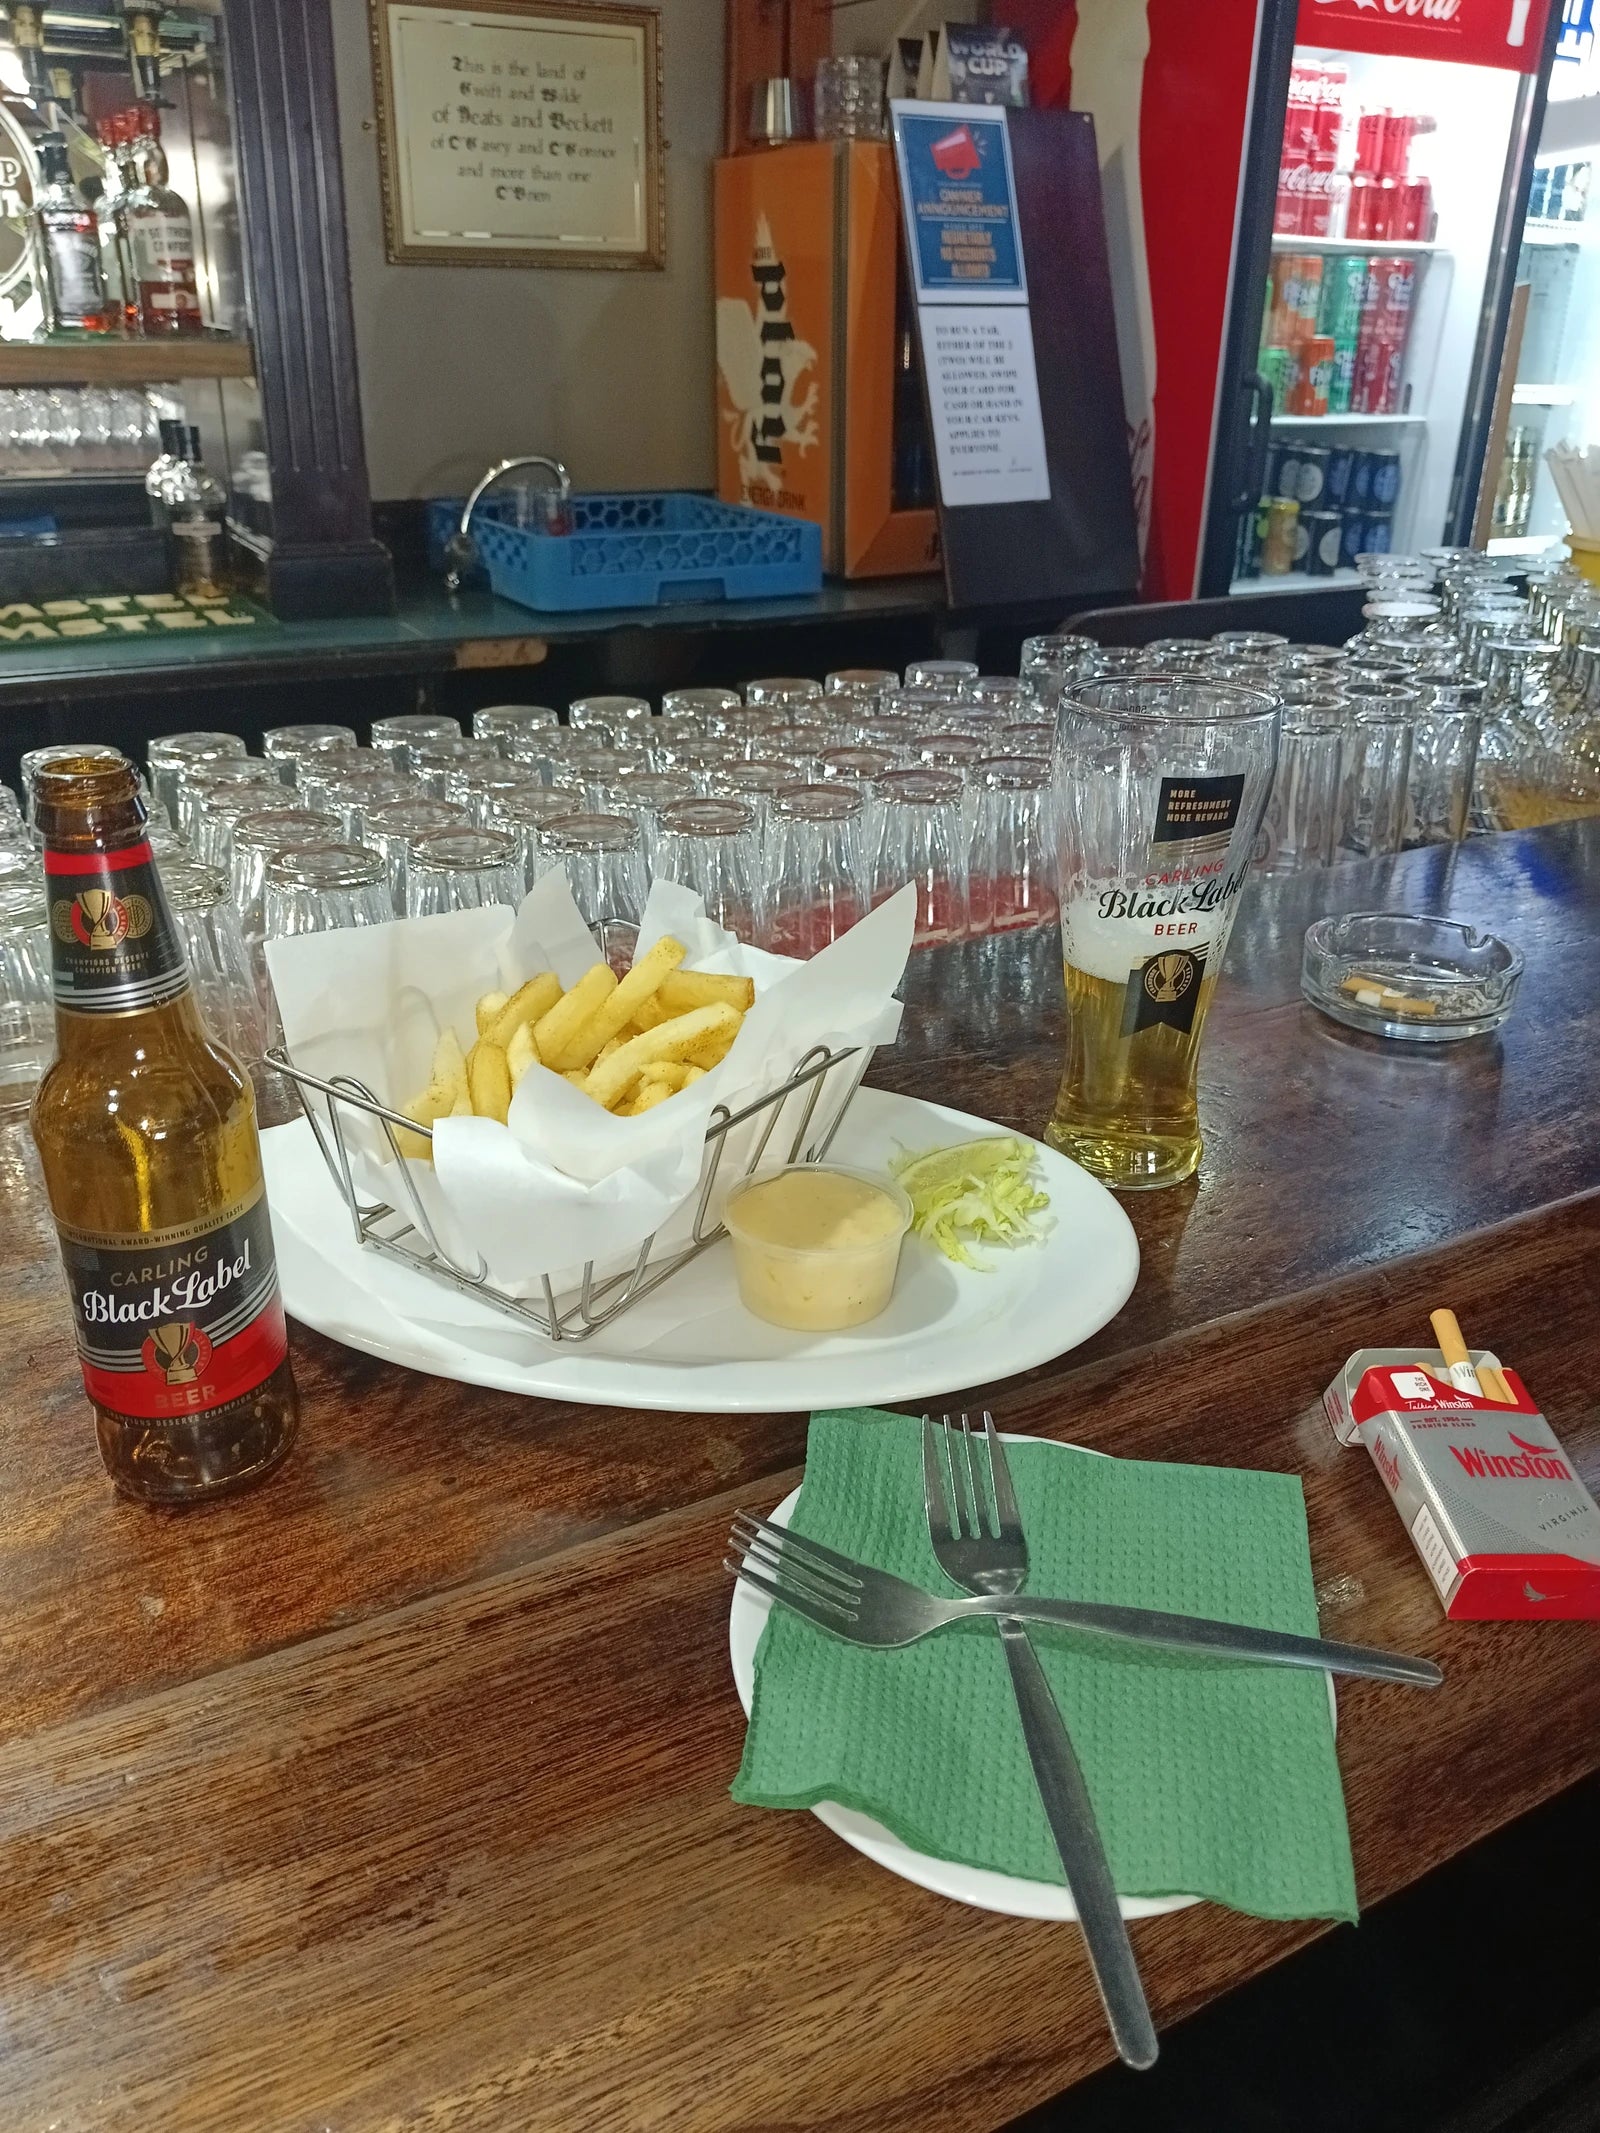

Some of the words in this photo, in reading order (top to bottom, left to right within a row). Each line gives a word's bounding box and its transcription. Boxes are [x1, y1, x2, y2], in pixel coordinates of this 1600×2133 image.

[452, 56, 485, 74] This
[508, 60, 529, 77] the
[536, 62, 566, 79] land
[573, 65, 587, 80] of
[968, 57, 1009, 75] CUP
[508, 85, 534, 99] and
[432, 104, 450, 123] of
[511, 109, 543, 128] and
[549, 112, 614, 133] Beckett
[431, 138, 446, 150] of
[518, 138, 544, 154] and
[457, 162, 483, 178] and
[490, 166, 526, 180] more
[567, 170, 591, 183] one
[1168, 799, 1231, 811] REFRESHMENT
[1170, 789, 1196, 799] MORE
[1167, 812, 1192, 822] MORE
[1195, 811, 1228, 822] REWARD
[1145, 858, 1225, 886] CARLING
[1098, 888, 1186, 919] Black
[1189, 859, 1249, 913] Label
[1154, 922, 1198, 936] BEER
[121, 1228, 191, 1246] AWARD-WINNING
[193, 1216, 224, 1233] QUALITY
[226, 1203, 243, 1219] TASTE
[110, 1245, 209, 1287] CARLING
[82, 1286, 175, 1324] Black
[171, 1238, 251, 1311] Label
[155, 1384, 217, 1409] BEER
[1404, 1400, 1439, 1410] Talking
[1436, 1398, 1474, 1409] Winston
[156, 1414, 199, 1427] DESERVE
[205, 1393, 251, 1419] CHAMPION
[1374, 1434, 1400, 1493] Winston
[1448, 1445, 1573, 1481] Winston
[1538, 1504, 1589, 1531] VIRGINIA
